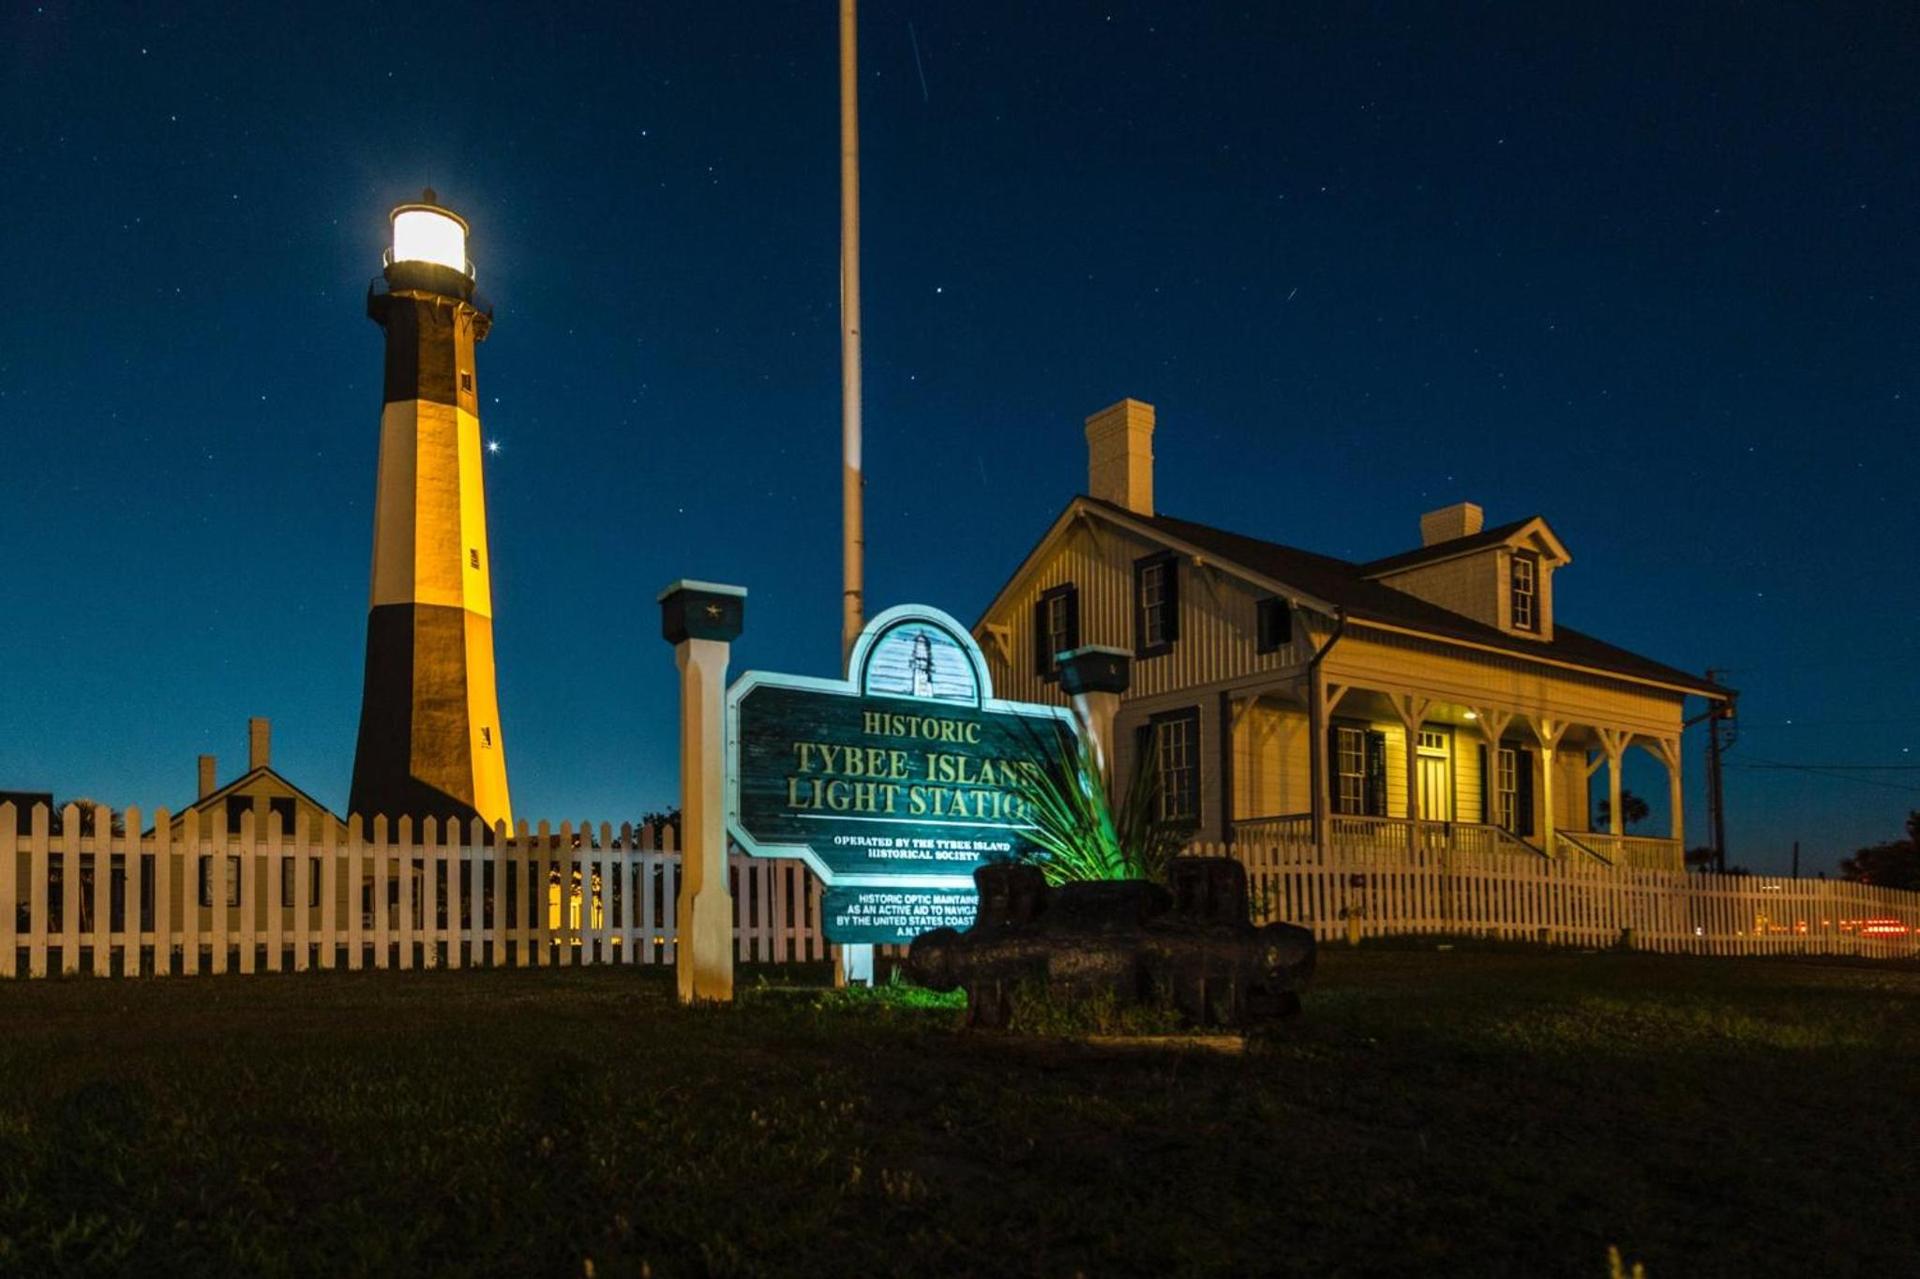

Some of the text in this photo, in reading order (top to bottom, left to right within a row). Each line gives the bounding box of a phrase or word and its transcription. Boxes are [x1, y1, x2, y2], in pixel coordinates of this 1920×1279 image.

[864, 711, 981, 744] HISTORIC
[793, 742, 909, 779] TYBEE
[787, 777, 1031, 819] LIGHT STATIO
[834, 836, 1011, 852] OPERATED BY THE TYBEE ISLAND
[868, 848, 980, 861] HISTORICAL SOCIETY
[859, 894, 902, 904] HISTORIC
[904, 895, 932, 905] OPTIC
[847, 905, 861, 914] AS
[863, 905, 876, 914] AN
[878, 905, 911, 915] ACTIVE
[913, 906, 929, 915] AID
[931, 906, 943, 915] TO
[836, 916, 975, 926] BY THE UNITED STATES COAST
